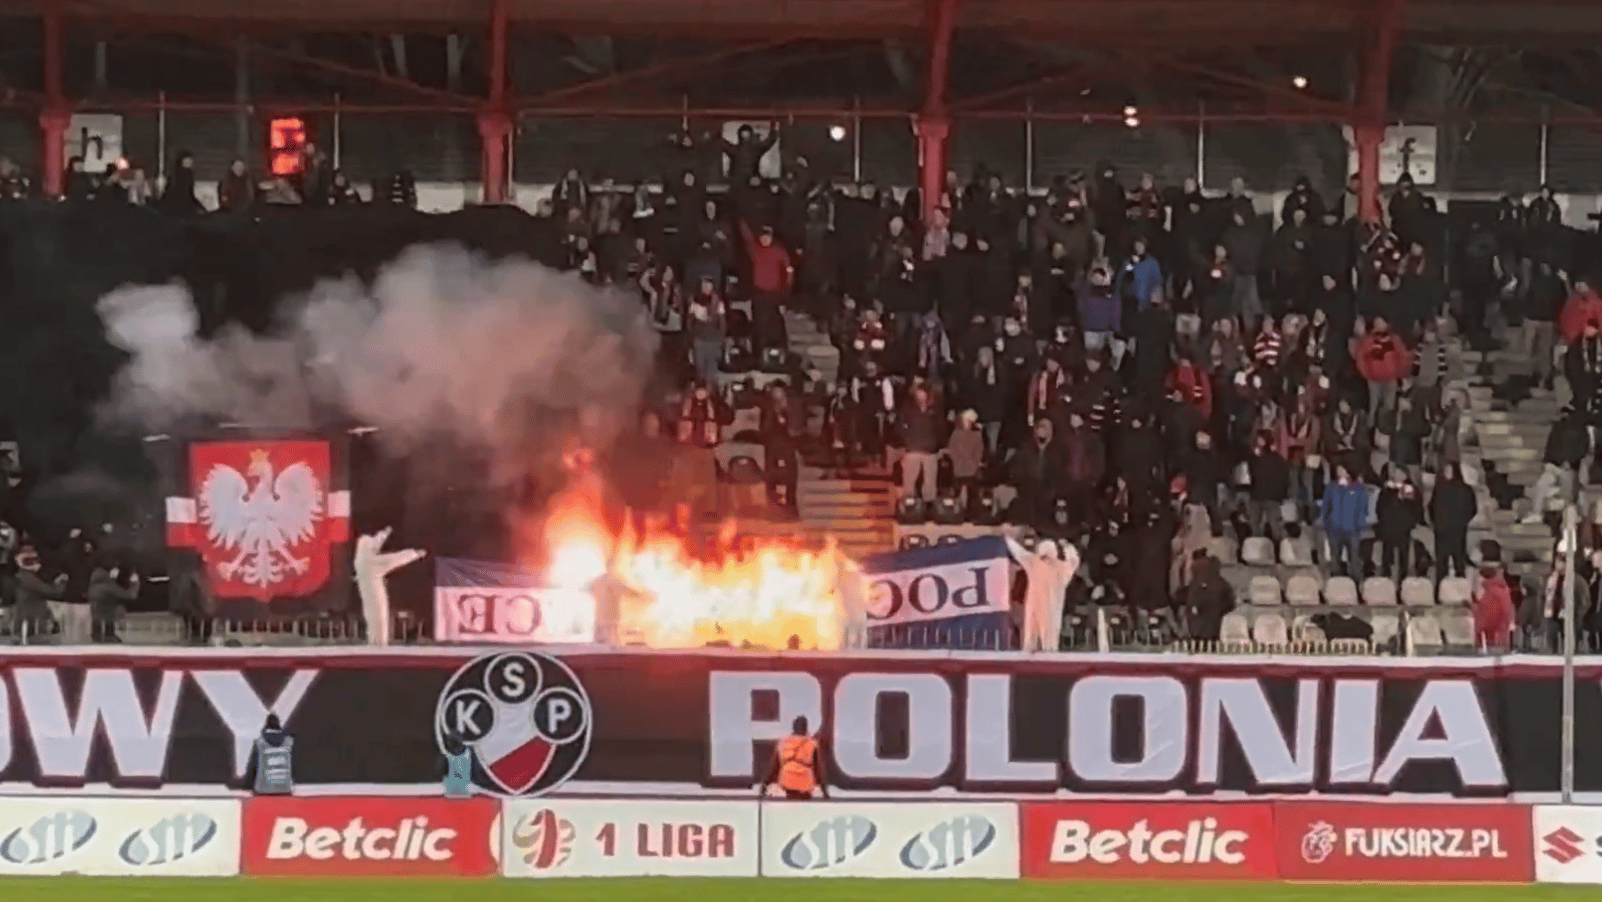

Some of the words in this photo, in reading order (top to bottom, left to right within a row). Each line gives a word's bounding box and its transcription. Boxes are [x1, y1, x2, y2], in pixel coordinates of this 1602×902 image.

[81, 126, 104, 160] h
[1399, 137, 1417, 173] f
[0, 668, 321, 778] WY
[709, 670, 1510, 786] POLONIA
[265, 815, 458, 861] Betclic
[595, 822, 616, 857] 1
[637, 822, 735, 858] LIGA
[1050, 816, 1249, 864] Betclic
[1344, 827, 1509, 858] FUKSIARZ.PL
